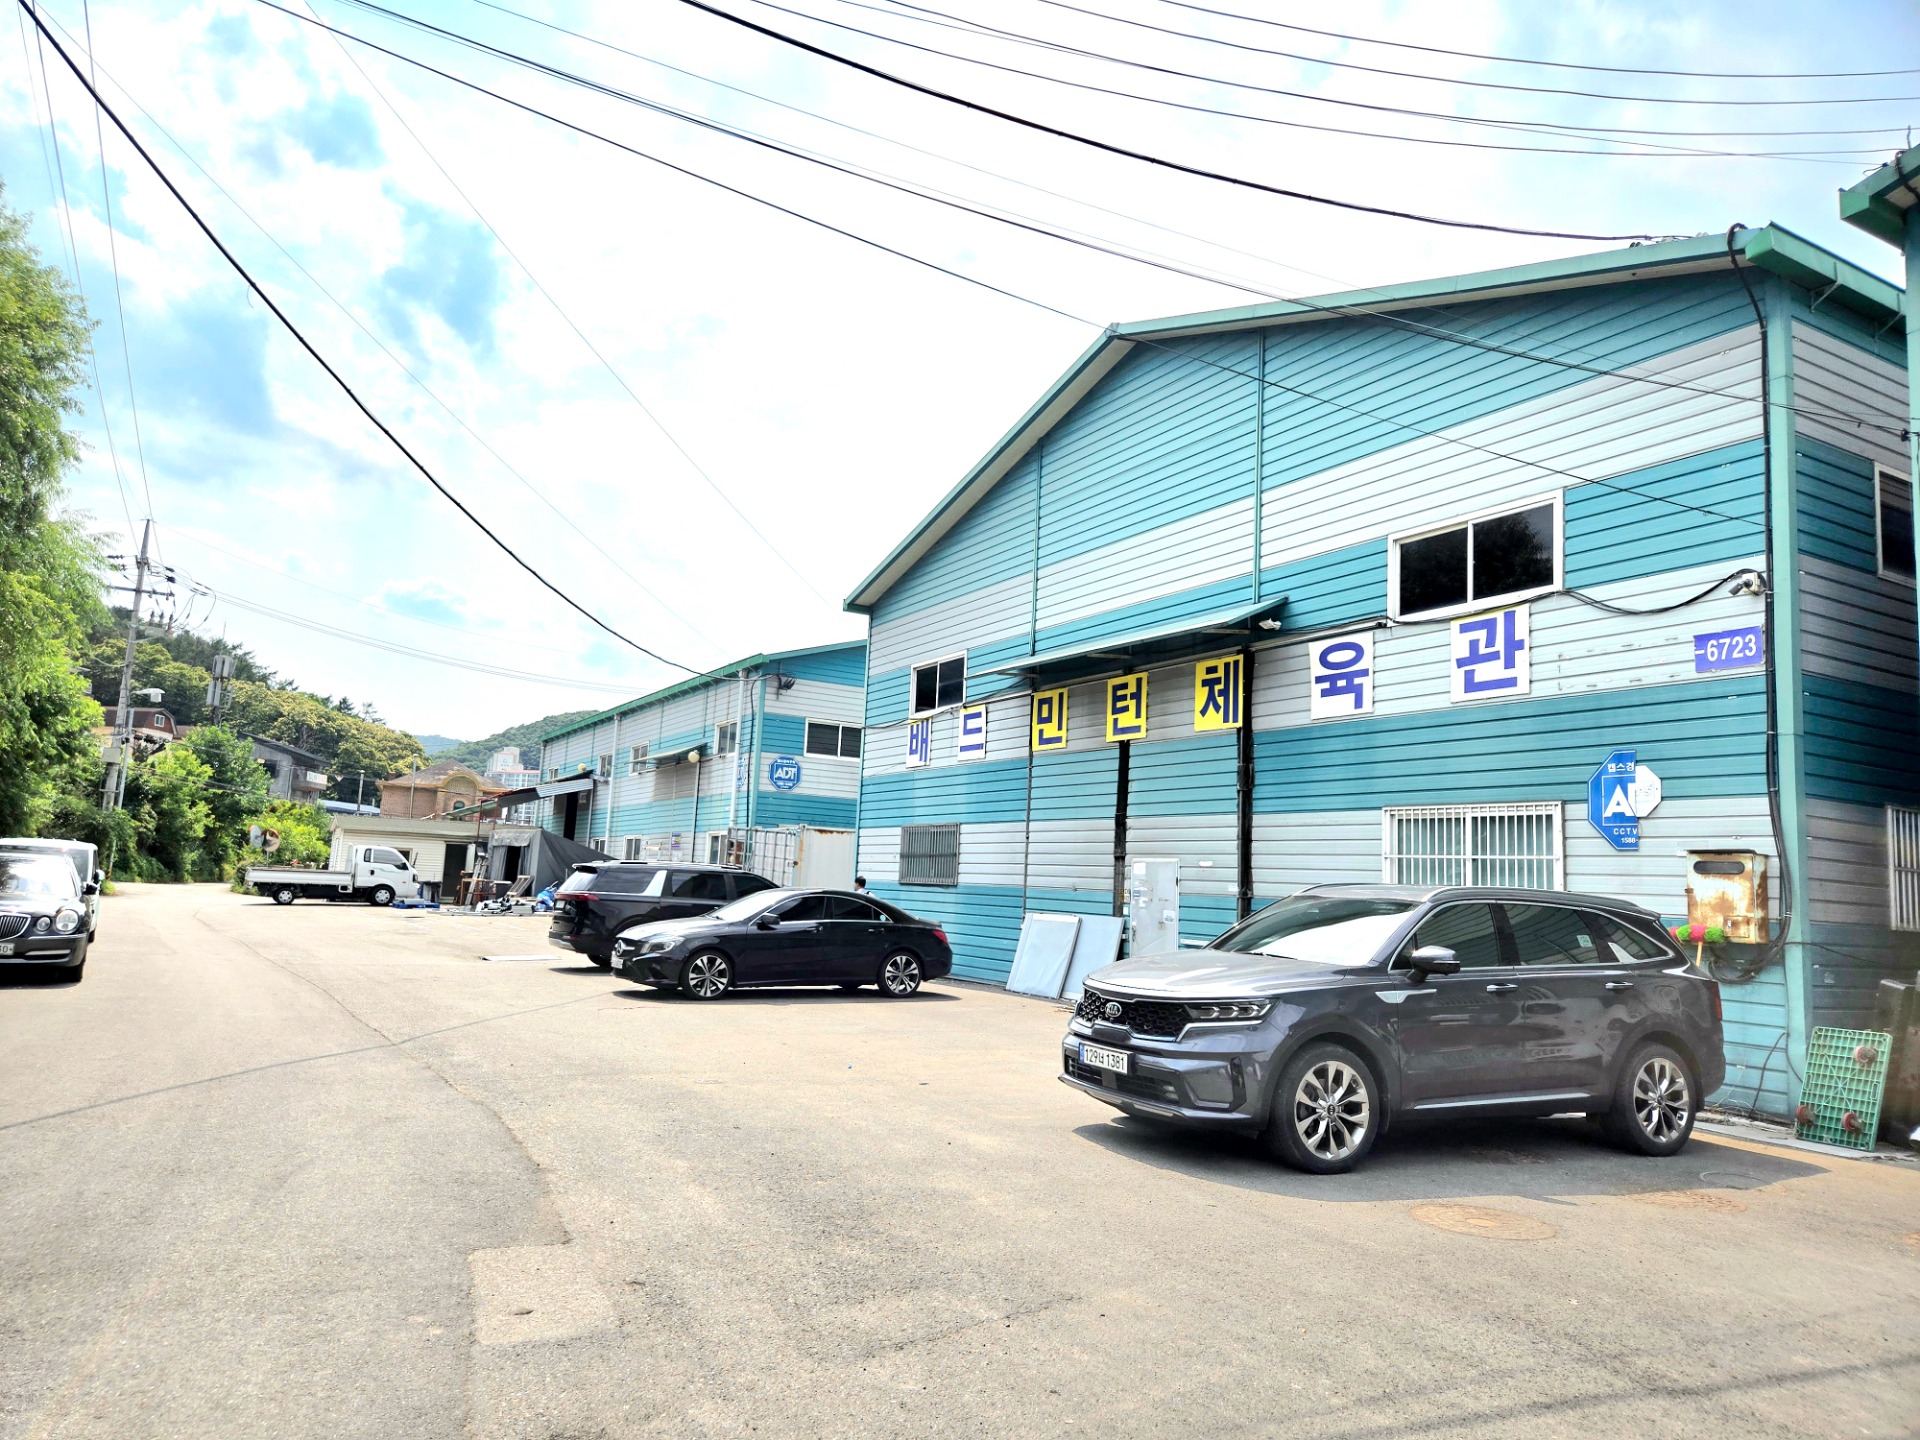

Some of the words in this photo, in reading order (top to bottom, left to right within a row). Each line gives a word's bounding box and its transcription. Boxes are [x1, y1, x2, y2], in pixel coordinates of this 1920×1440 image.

[1694, 634, 1757, 662] -6723
[775, 767, 797, 780] ADT
[1613, 827, 1638, 835] CCTV
